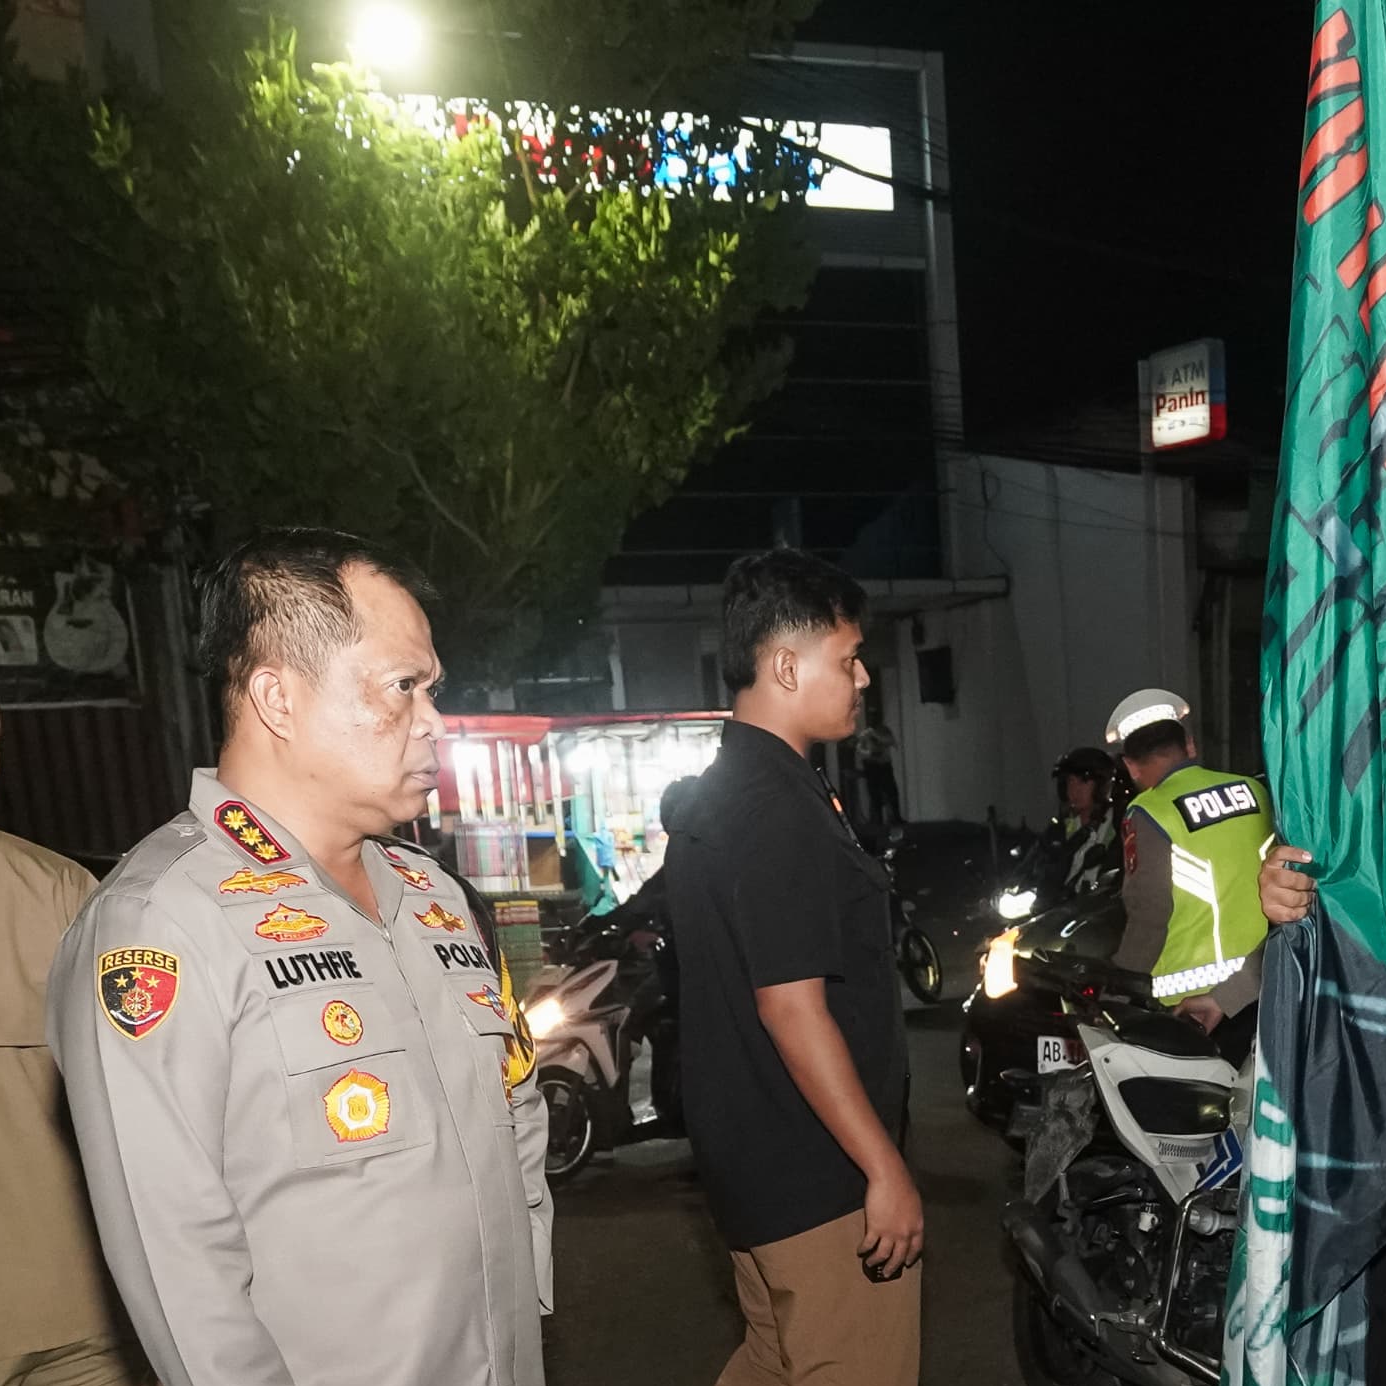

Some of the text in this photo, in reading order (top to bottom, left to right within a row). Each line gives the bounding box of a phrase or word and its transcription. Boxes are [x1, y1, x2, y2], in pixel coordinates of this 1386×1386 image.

[1172, 360, 1205, 387] ATM
[1184, 783, 1257, 824] POLISI
[104, 950, 175, 970] RESERSE
[265, 950, 363, 990] LUTHFIE
[433, 943, 491, 971] POLRI
